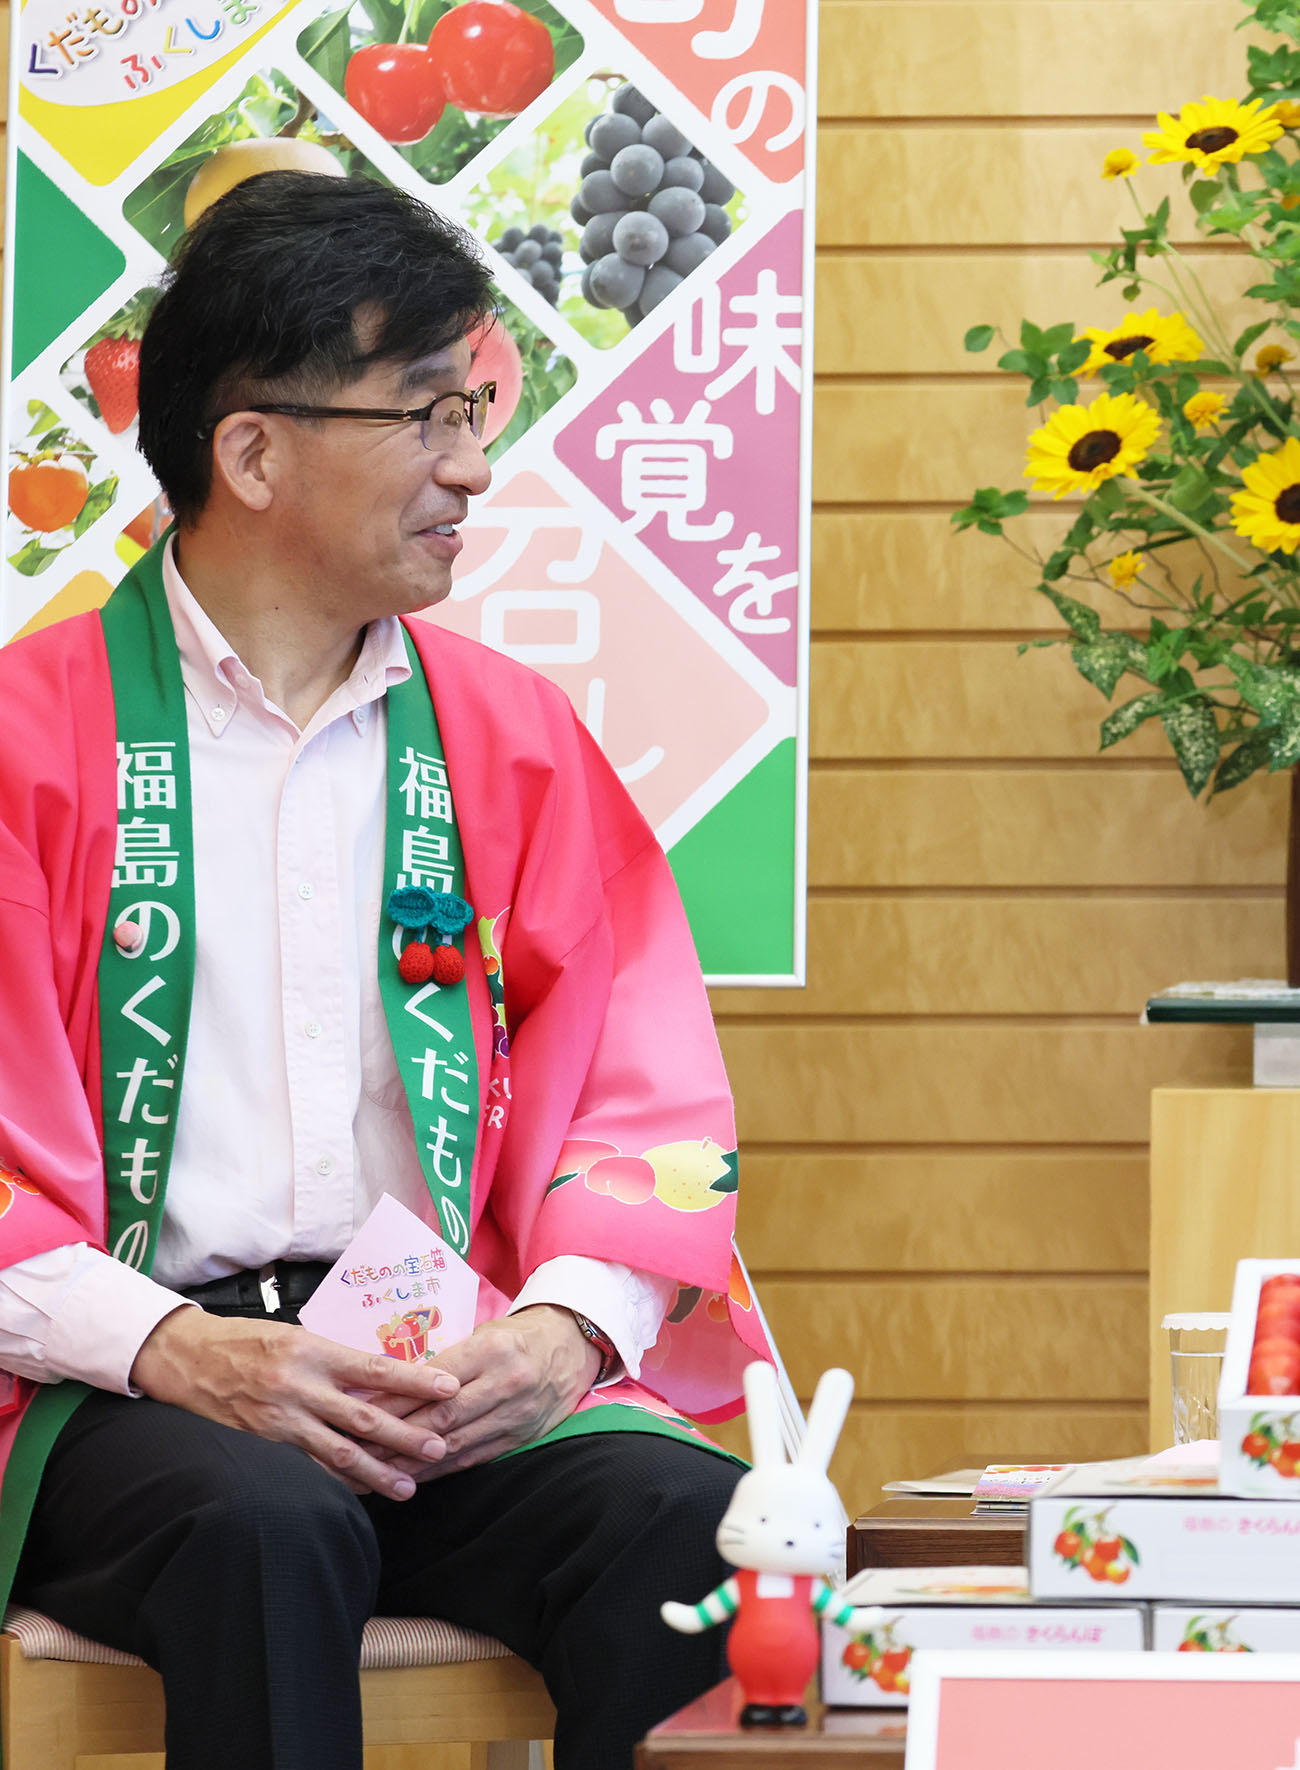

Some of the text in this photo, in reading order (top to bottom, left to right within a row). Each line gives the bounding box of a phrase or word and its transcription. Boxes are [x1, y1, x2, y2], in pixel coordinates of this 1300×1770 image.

[340, 1247, 447, 1286] くだものの宝石箱
[361, 1276, 441, 1307] ふくしま市
